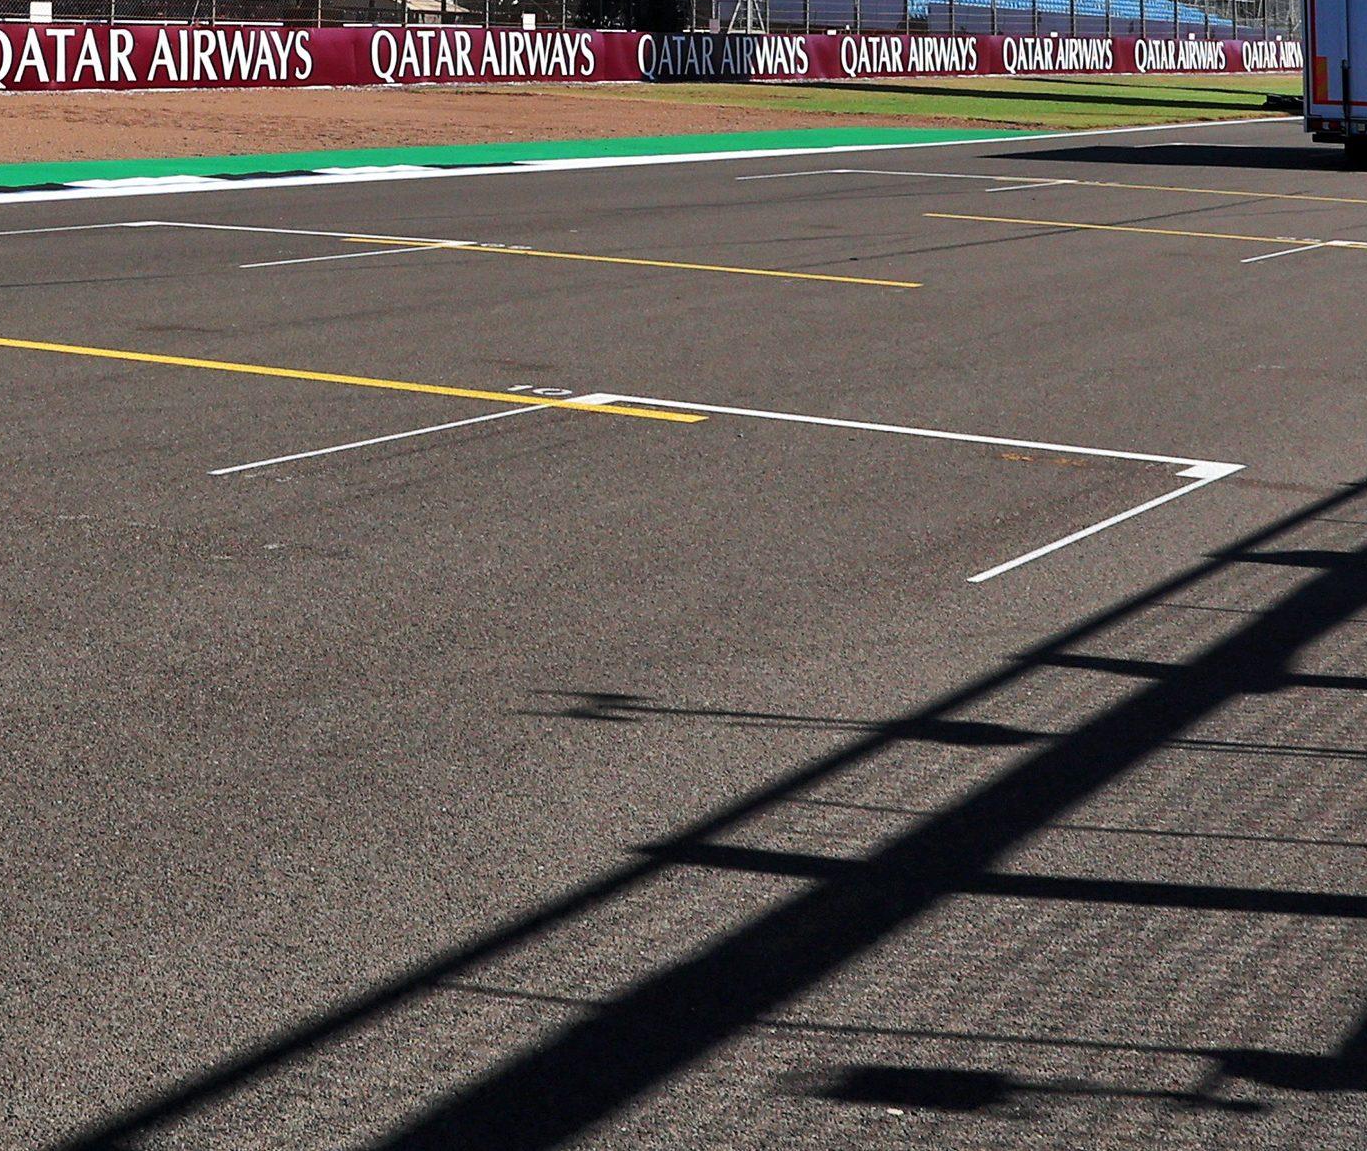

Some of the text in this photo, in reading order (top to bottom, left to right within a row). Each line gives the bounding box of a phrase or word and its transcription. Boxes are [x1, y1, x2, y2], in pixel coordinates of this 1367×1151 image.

[148, 28, 313, 82] AIRWAYS
[371, 30, 596, 83] QATAR AIRWAYS
[637, 33, 809, 80] QATAR AIRWAYS
[841, 35, 977, 78] QATAR AIRWAYS
[1003, 37, 1113, 74] QATAR AIRWAYS
[1135, 39, 1226, 73] QATAR AIRWAYS
[1242, 40, 1279, 72] QATAR
[506, 384, 573, 397] 10
